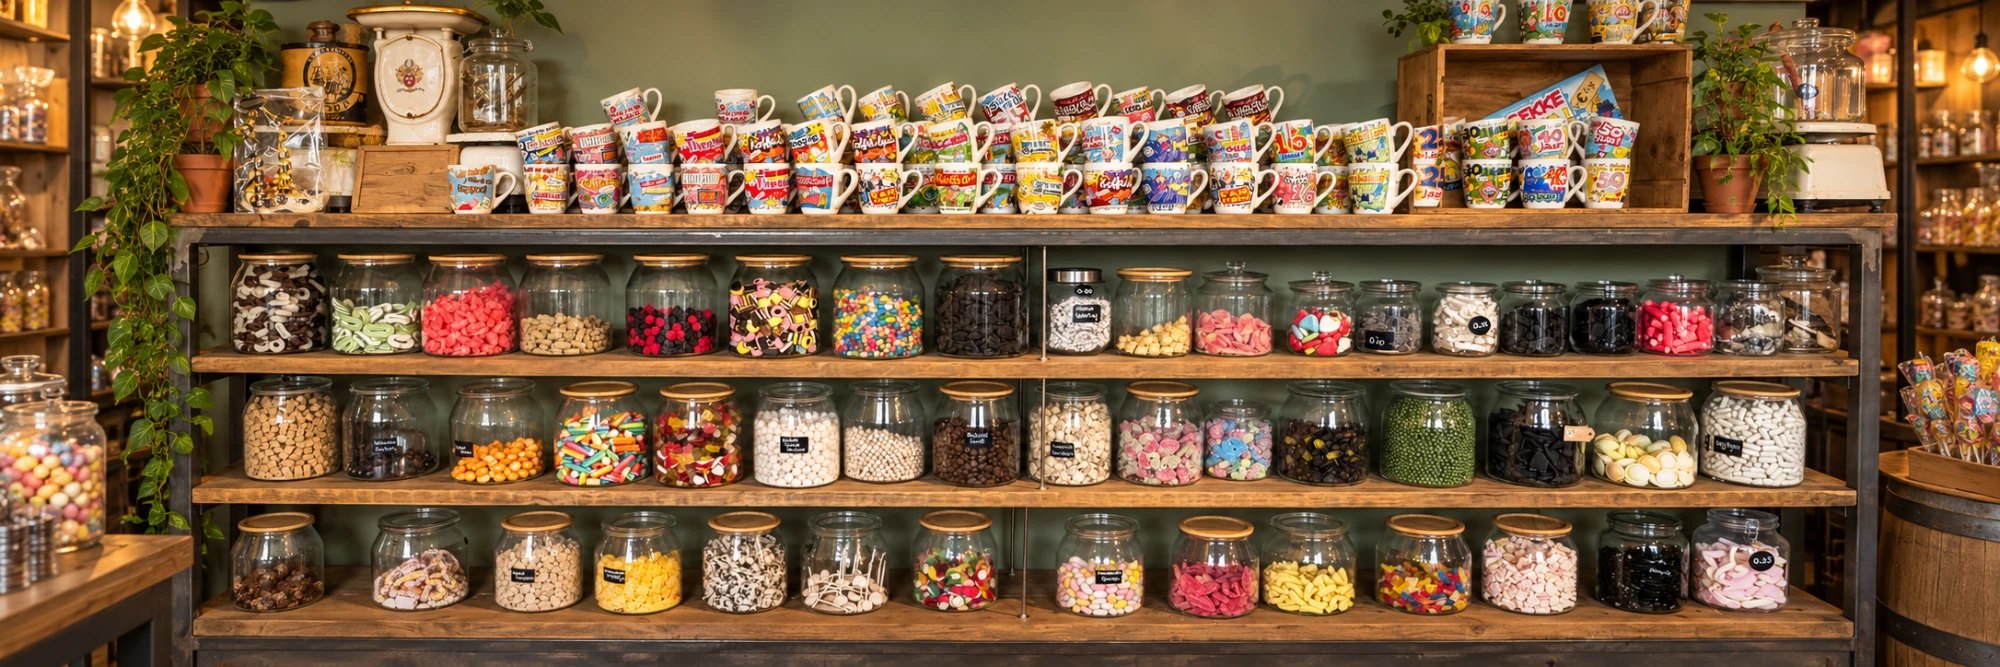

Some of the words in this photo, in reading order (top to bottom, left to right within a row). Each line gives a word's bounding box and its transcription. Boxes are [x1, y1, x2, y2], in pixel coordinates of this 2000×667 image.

[1506, 89, 1565, 121] EKKE
[1598, 122, 1624, 138] 50
[1753, 555, 1773, 565] 0.25
